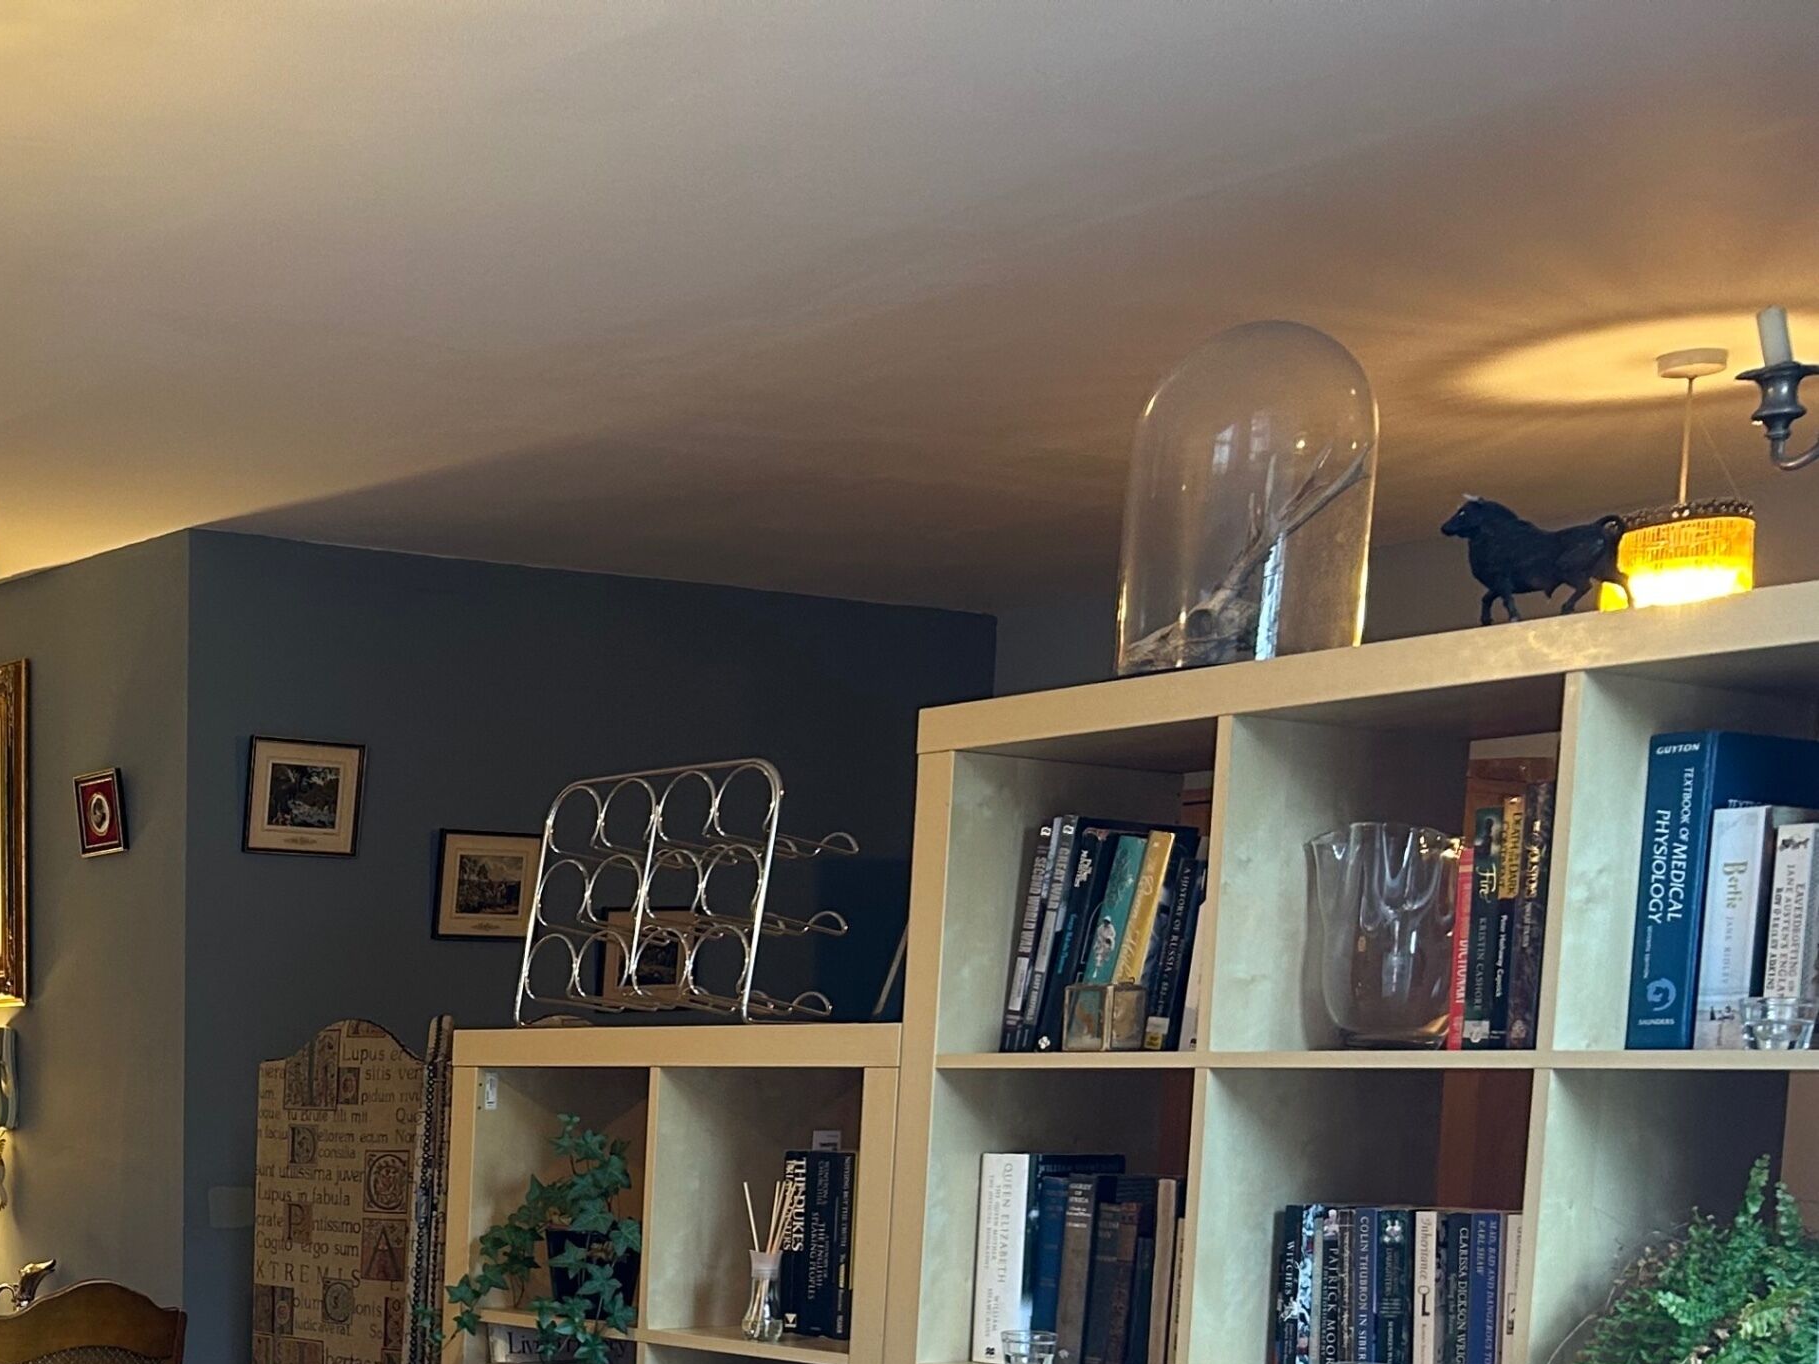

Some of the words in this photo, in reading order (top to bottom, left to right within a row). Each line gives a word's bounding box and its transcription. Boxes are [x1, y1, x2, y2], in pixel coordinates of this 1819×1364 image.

[1655, 742, 1701, 755] GUYTON
[1679, 767, 1695, 824] TEXTBOOK
[1511, 813, 1522, 849] DEATH
[1680, 827, 1689, 843] OF
[1029, 857, 1046, 894] SECOND
[1053, 848, 1069, 881] GREAT
[1508, 864, 1518, 894] DARK
[1648, 809, 1671, 924] PHYSIOLOGY
[1666, 842, 1688, 923] MEDICAL
[1785, 864, 1796, 894] JANE
[1048, 883, 1062, 909] WAR
[1722, 861, 1750, 909] Bertie
[1023, 896, 1040, 929] WORLD
[1019, 931, 1033, 953] WAR
[1164, 935, 1180, 973] RUSSIA
[1476, 917, 1488, 960] KRISTIN
[1474, 963, 1485, 1011] CASHORE
[1776, 953, 1788, 997] ENGLA
[342, 1041, 385, 1064] Lupus
[257, 1182, 292, 1204] Lupus
[313, 1187, 350, 1206] fabula
[1001, 1163, 1013, 1207] QUEEN
[790, 1195, 805, 1251] DUKES
[808, 1212, 819, 1258] SPEAKING
[817, 1223, 826, 1242] THE
[1360, 1217, 1369, 1252] COLIN
[301, 1241, 330, 1259] ergo
[334, 1243, 359, 1257] sum
[996, 1214, 1010, 1283] ELIZABETH
[1419, 1217, 1432, 1280] Inheritance
[1457, 1228, 1469, 1278] CLARISSA
[1487, 1247, 1496, 1267] BAD
[808, 1261, 817, 1299] PEOPLES
[1285, 1241, 1296, 1295] WITCHES
[1326, 1247, 1338, 1312] PATRICK
[1359, 1256, 1369, 1310] THUBRON
[1486, 1268, 1495, 1288] AND
[1359, 1314, 1368, 1327] IN
[1456, 1281, 1467, 1330] DICKSON
[1485, 1291, 1493, 1350] DANGEROUS
[1358, 1330, 1367, 1360] SIBER
[1484, 1353, 1491, 1364] TO
